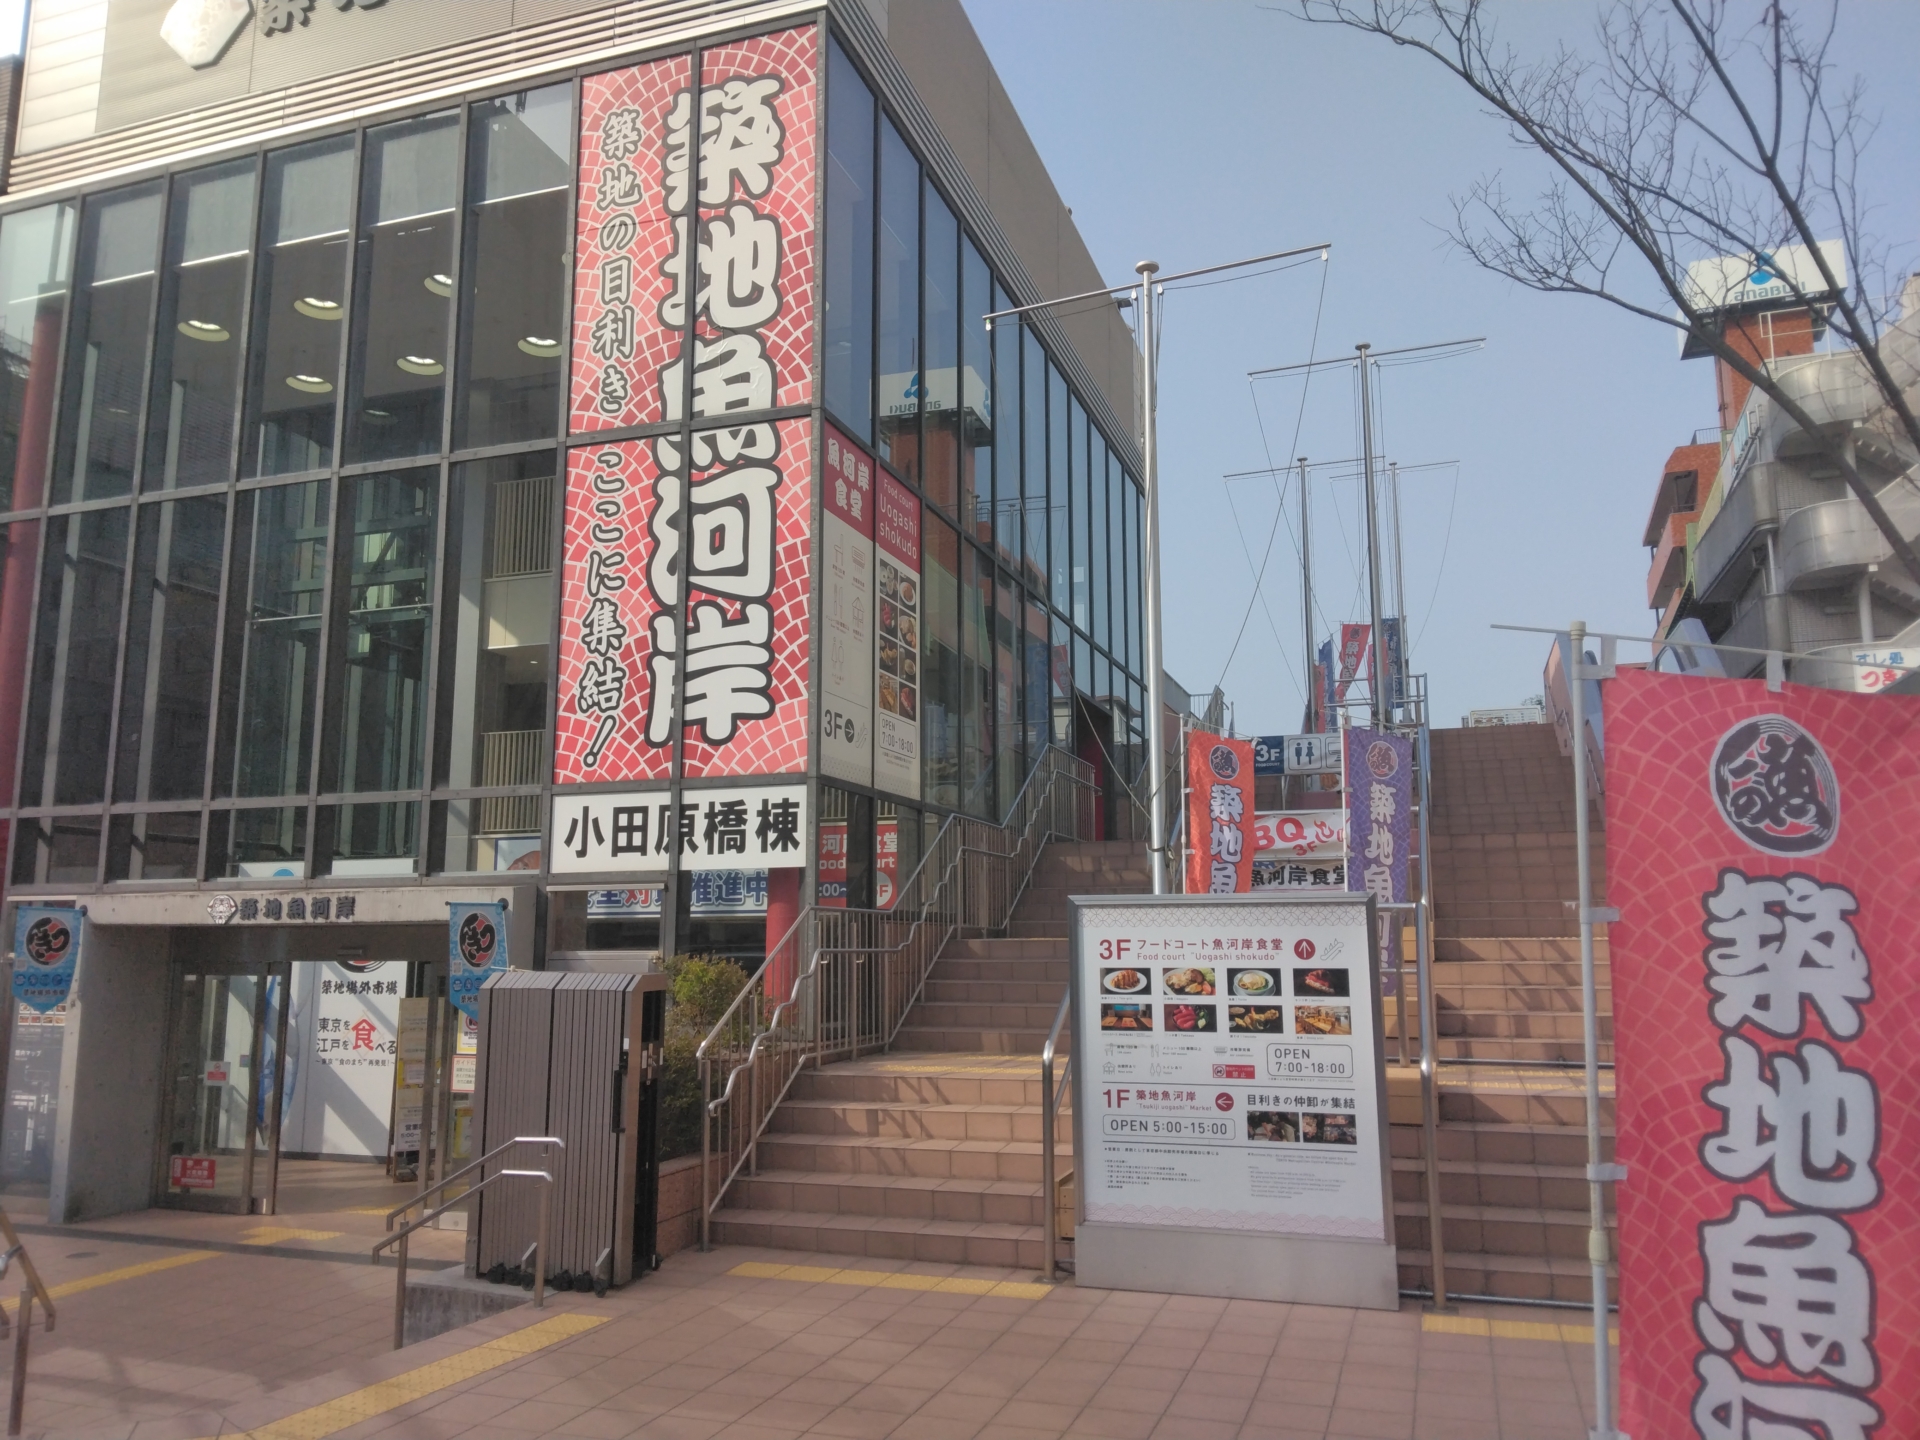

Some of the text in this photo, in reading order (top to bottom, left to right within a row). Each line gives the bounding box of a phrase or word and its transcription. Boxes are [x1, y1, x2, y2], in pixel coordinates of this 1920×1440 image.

[591, 105, 643, 415] 築地の目利き
[1734, 281, 1806, 302] anaBUI
[645, 73, 786, 748] 築地魚河岸
[828, 437, 870, 492] 魚河岸
[835, 477, 863, 522] 食堂
[883, 479, 914, 513] Food court
[880, 493, 917, 538] Uogashi
[880, 522, 917, 560] shokudo
[824, 709, 843, 740] 3F
[882, 718, 896, 733] OPEN
[882, 731, 914, 754] 7:00-18:00
[1255, 744, 1281, 762] 3F
[563, 797, 801, 859] 小田原橋棟
[1292, 840, 1318, 857] 3F
[1250, 864, 1345, 887] 魚河岸食堂
[239, 895, 356, 921] 築地魚河岸
[1100, 939, 1131, 960] 3F
[1136, 938, 1283, 951] フードコート魚河岸食堂
[1137, 953, 1158, 961] Food
[1162, 953, 1185, 961] court
[321, 980, 398, 995] 築地場外市場
[317, 1017, 351, 1033] 東京を
[316, 1038, 350, 1053] 江戸を
[1274, 1048, 1311, 1060] OPEN
[1275, 1061, 1345, 1074] 7:00-18:00
[1103, 1089, 1130, 1109] 1F
[1136, 1089, 1197, 1102] 築地魚河岸
[1247, 1094, 1356, 1109] 目利きの仲卸が集結
[1110, 1119, 1228, 1135] OPEN 5:00-15:00
